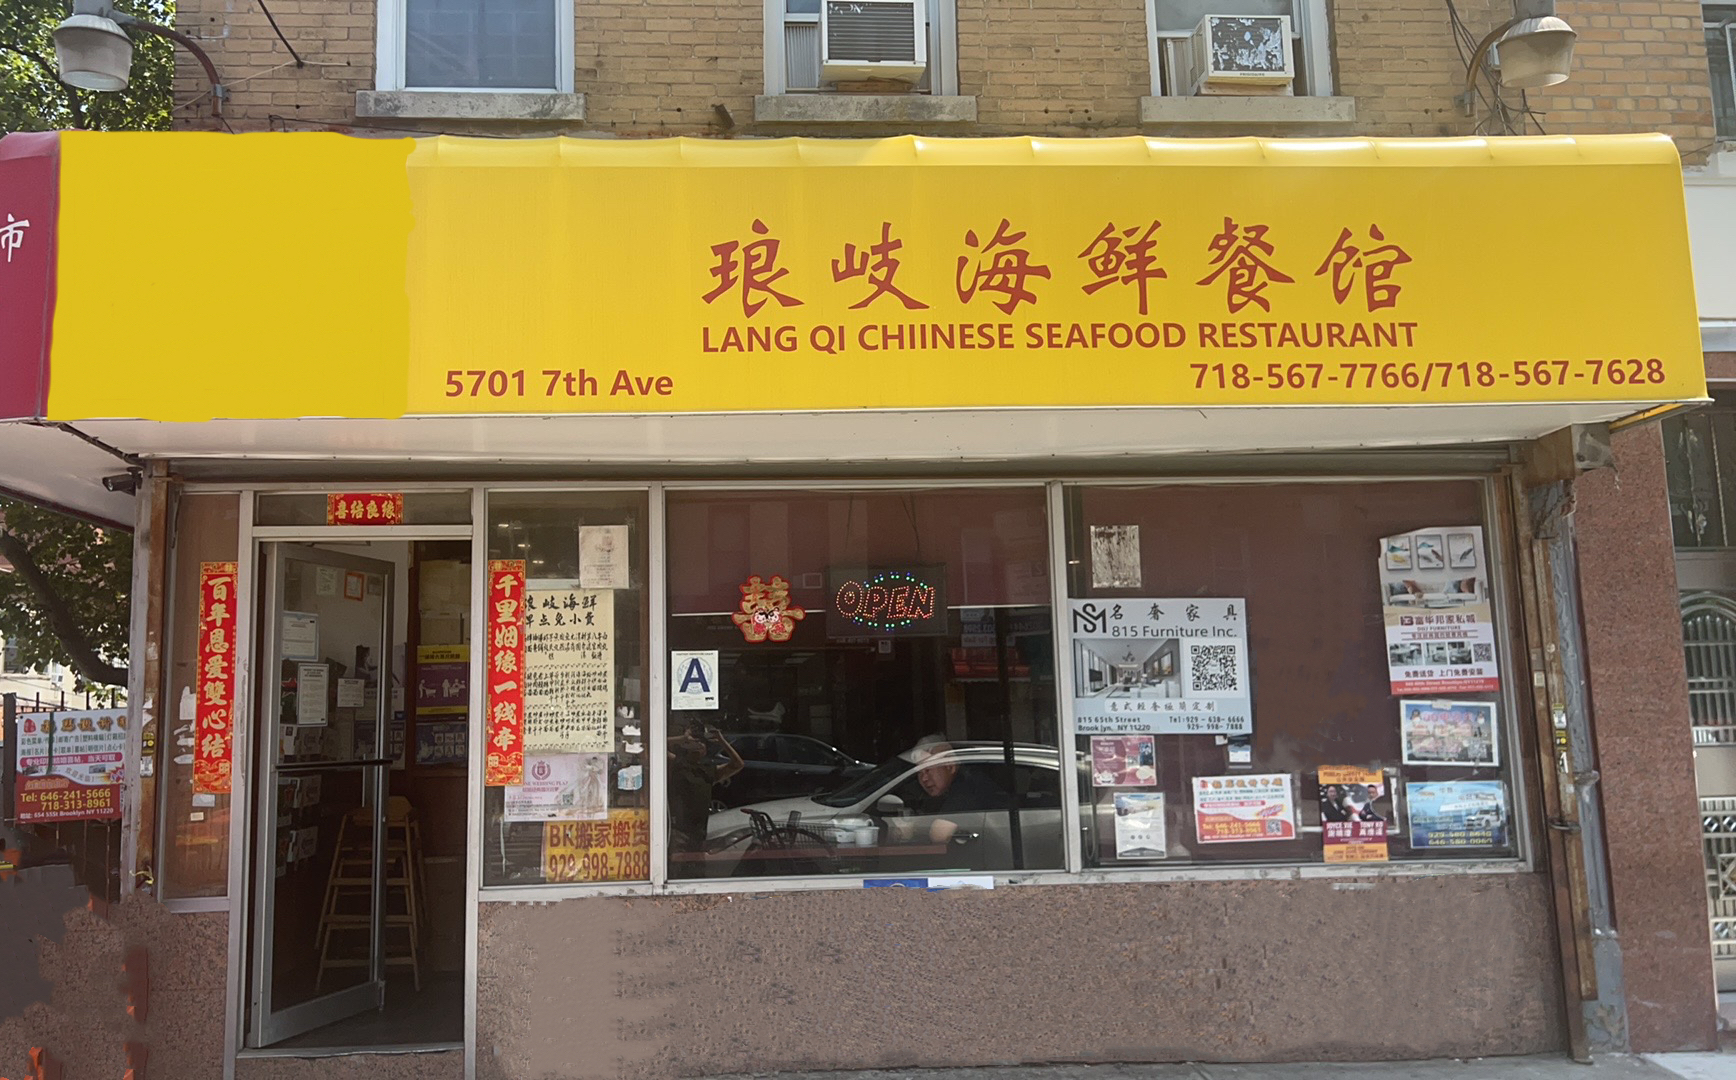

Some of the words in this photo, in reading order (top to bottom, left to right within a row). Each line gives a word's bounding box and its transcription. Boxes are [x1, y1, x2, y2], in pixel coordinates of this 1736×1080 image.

[702, 217, 1413, 318] 琅岐海鲜餐馆
[702, 325, 798, 353] LANG
[809, 325, 845, 355] QI
[857, 323, 1015, 351] CHIINESE
[1025, 322, 1187, 349] SEAFOOD
[1198, 321, 1418, 349] RESTAURANT
[445, 369, 525, 397] 5701
[542, 368, 598, 397] 7th
[609, 369, 674, 396] Ave
[1192, 358, 1666, 392] 718-567-7766/718-567-7628
[835, 581, 936, 619] OPEN
[1111, 625, 1138, 637] 815
[1142, 625, 1209, 638] Furniture
[1212, 625, 1238, 638] Inc.
[679, 658, 711, 692] A
[20, 793, 38, 802] Tel:
[39, 788, 111, 801] 646-241-5666
[41, 798, 111, 811] 718-313-8961
